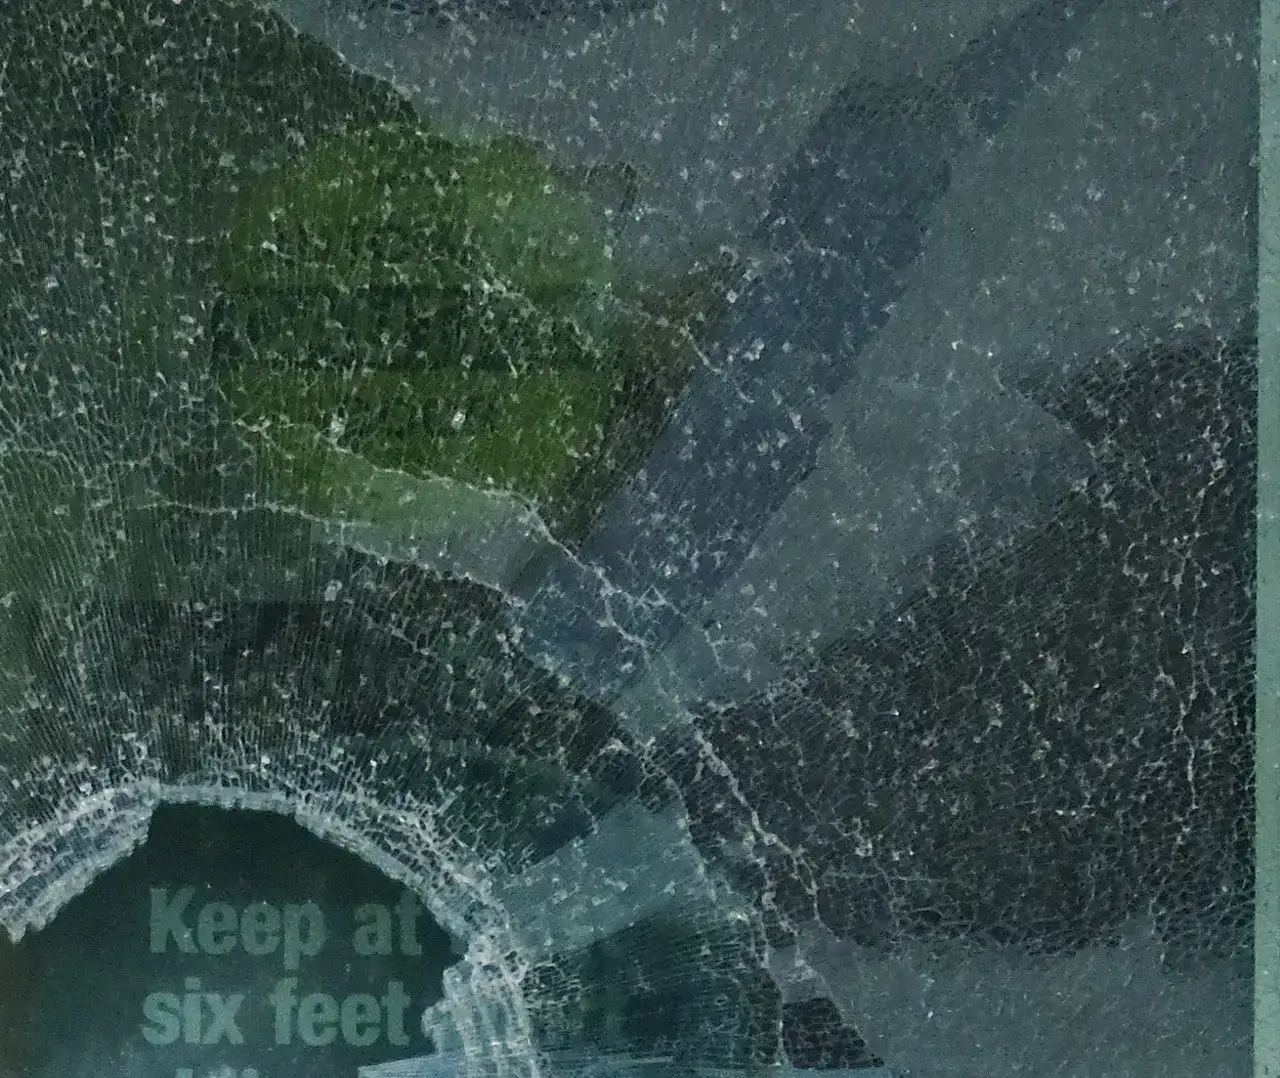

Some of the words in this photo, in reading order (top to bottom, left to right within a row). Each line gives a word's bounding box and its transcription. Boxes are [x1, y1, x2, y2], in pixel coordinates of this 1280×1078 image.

[149, 886, 327, 970] Keep
[353, 890, 423, 956] at
[141, 978, 245, 1046] six
[270, 977, 412, 1046] feet
